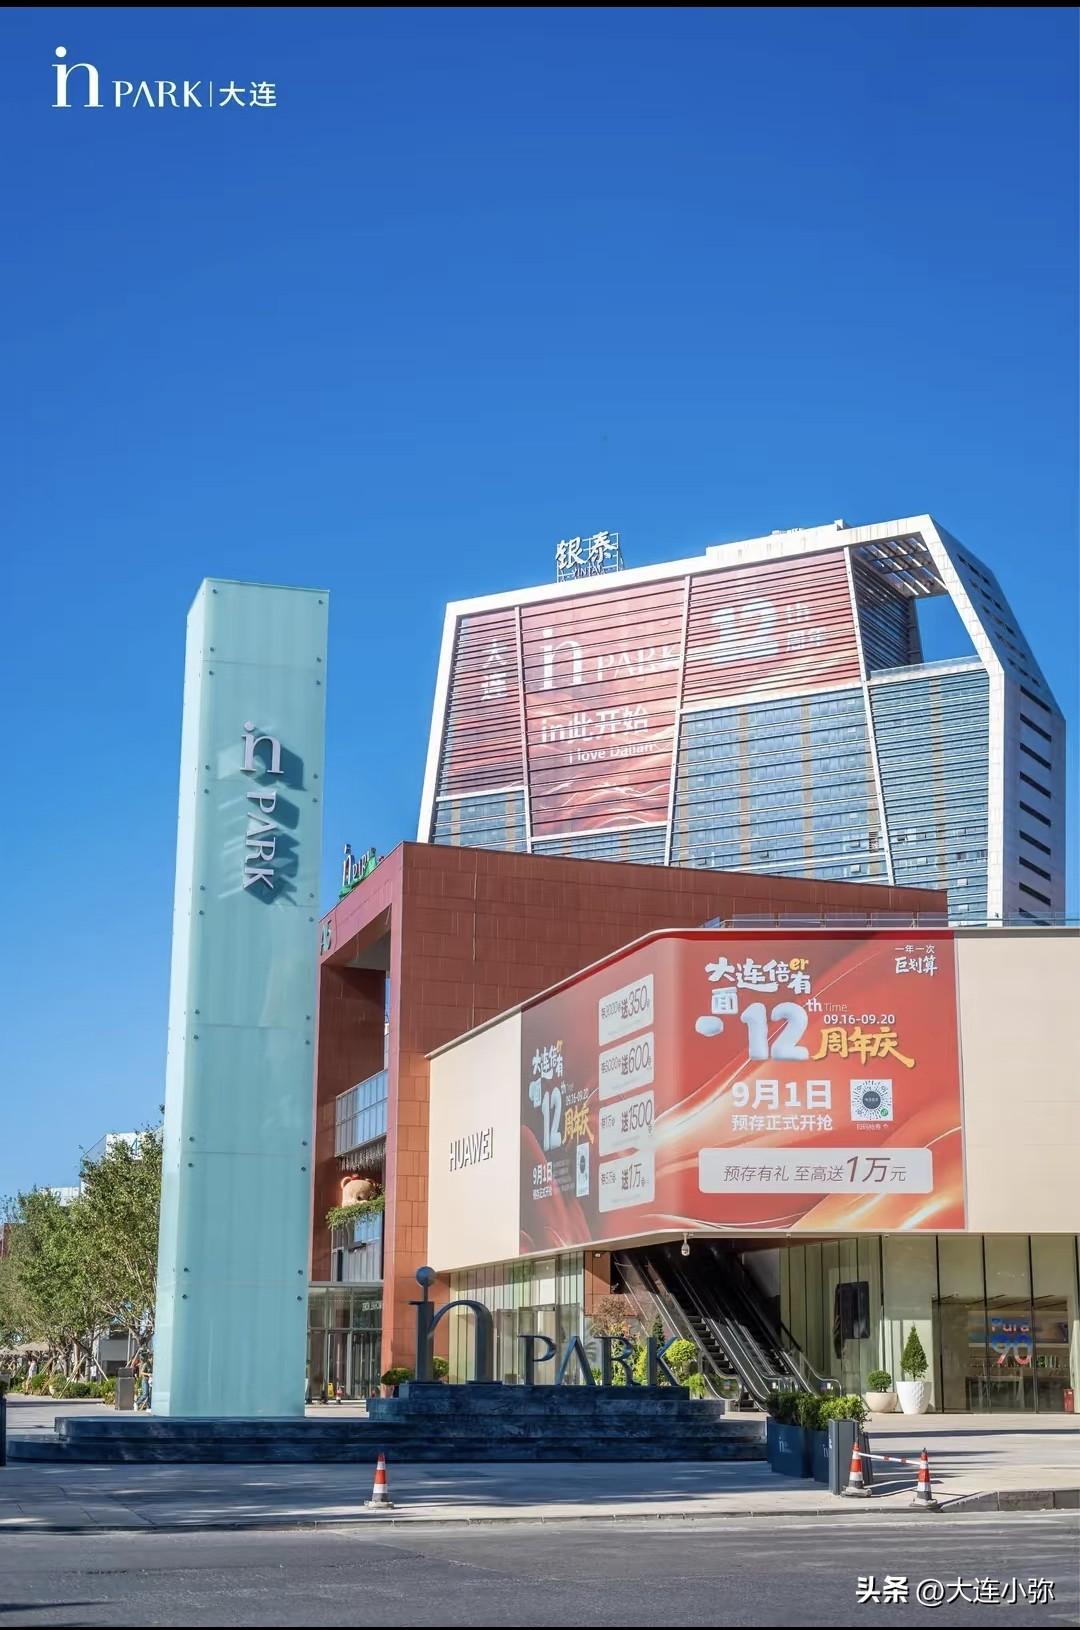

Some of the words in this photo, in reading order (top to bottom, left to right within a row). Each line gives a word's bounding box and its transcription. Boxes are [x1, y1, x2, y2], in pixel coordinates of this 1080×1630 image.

[556, 531, 618, 570] 银泰
[540, 627, 588, 690] in
[596, 645, 682, 682] PARK
[240, 721, 284, 774] in
[243, 791, 279, 890] PARK
[895, 944, 936, 953] 一年一次
[895, 956, 938, 977] 巨划算
[823, 1002, 848, 1013] Time
[823, 1014, 896, 1025] 09.16-09.20
[811, 1026, 916, 1068] 周年庆
[731, 1079, 832, 1110] 9月1日
[731, 1114, 833, 1132] 预存正式开抢
[449, 1126, 493, 1172] HUAWEI
[532, 1161, 553, 1185] 9月1日
[723, 1165, 790, 1182] 预存有礼
[794, 1155, 906, 1183] 至高送1万元
[409, 1266, 502, 1384] in
[517, 1335, 682, 1387] PARK
